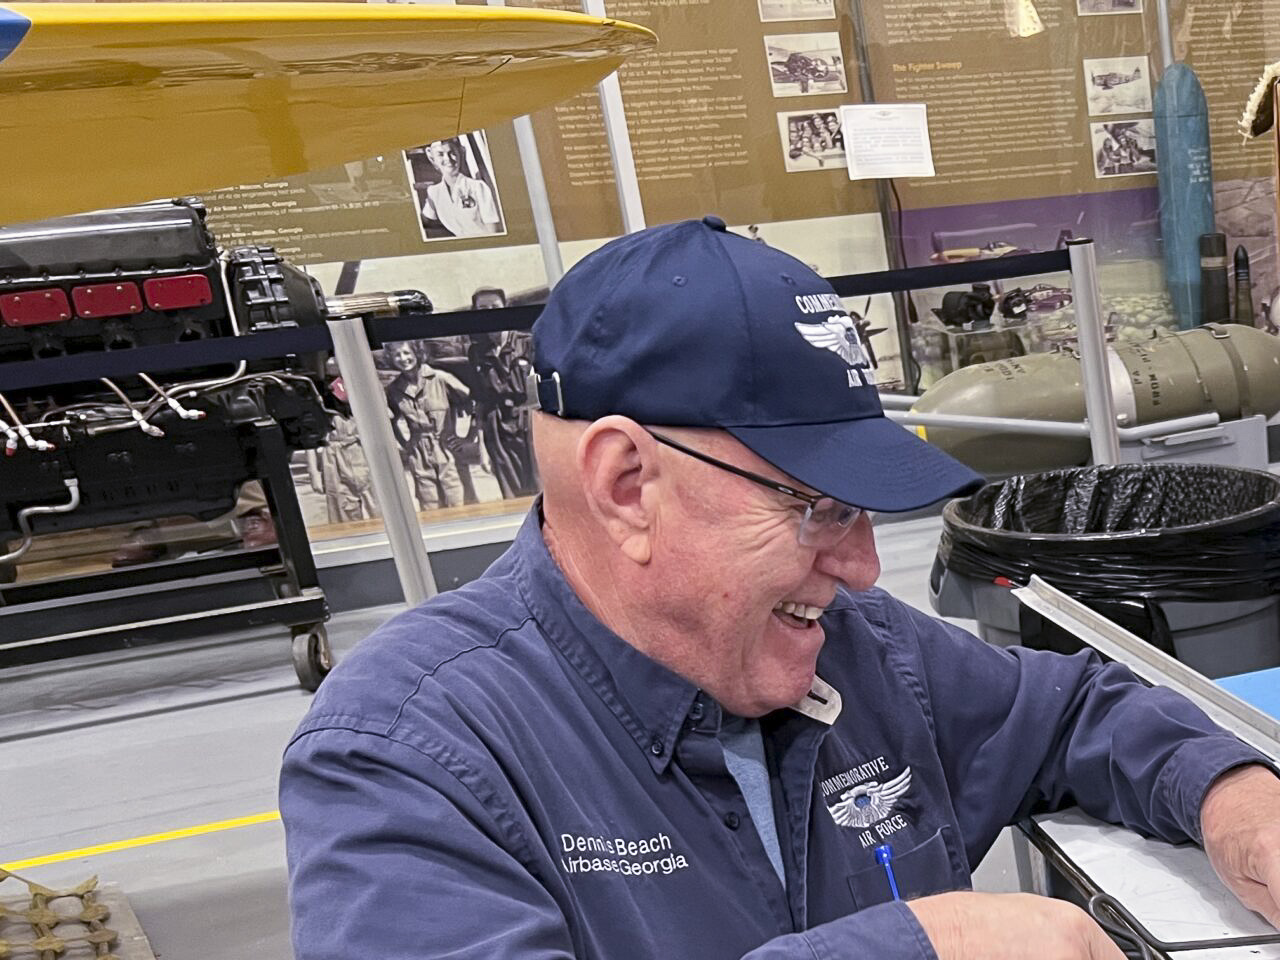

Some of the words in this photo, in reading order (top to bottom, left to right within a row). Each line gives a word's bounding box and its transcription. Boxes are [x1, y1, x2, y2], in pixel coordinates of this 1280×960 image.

[821, 756, 889, 797] OMMEMORATIVE
[615, 832, 672, 856] Beach
[858, 830, 877, 849] AIR
[875, 814, 908, 840] FORCE
[619, 853, 689, 875] Georgia
